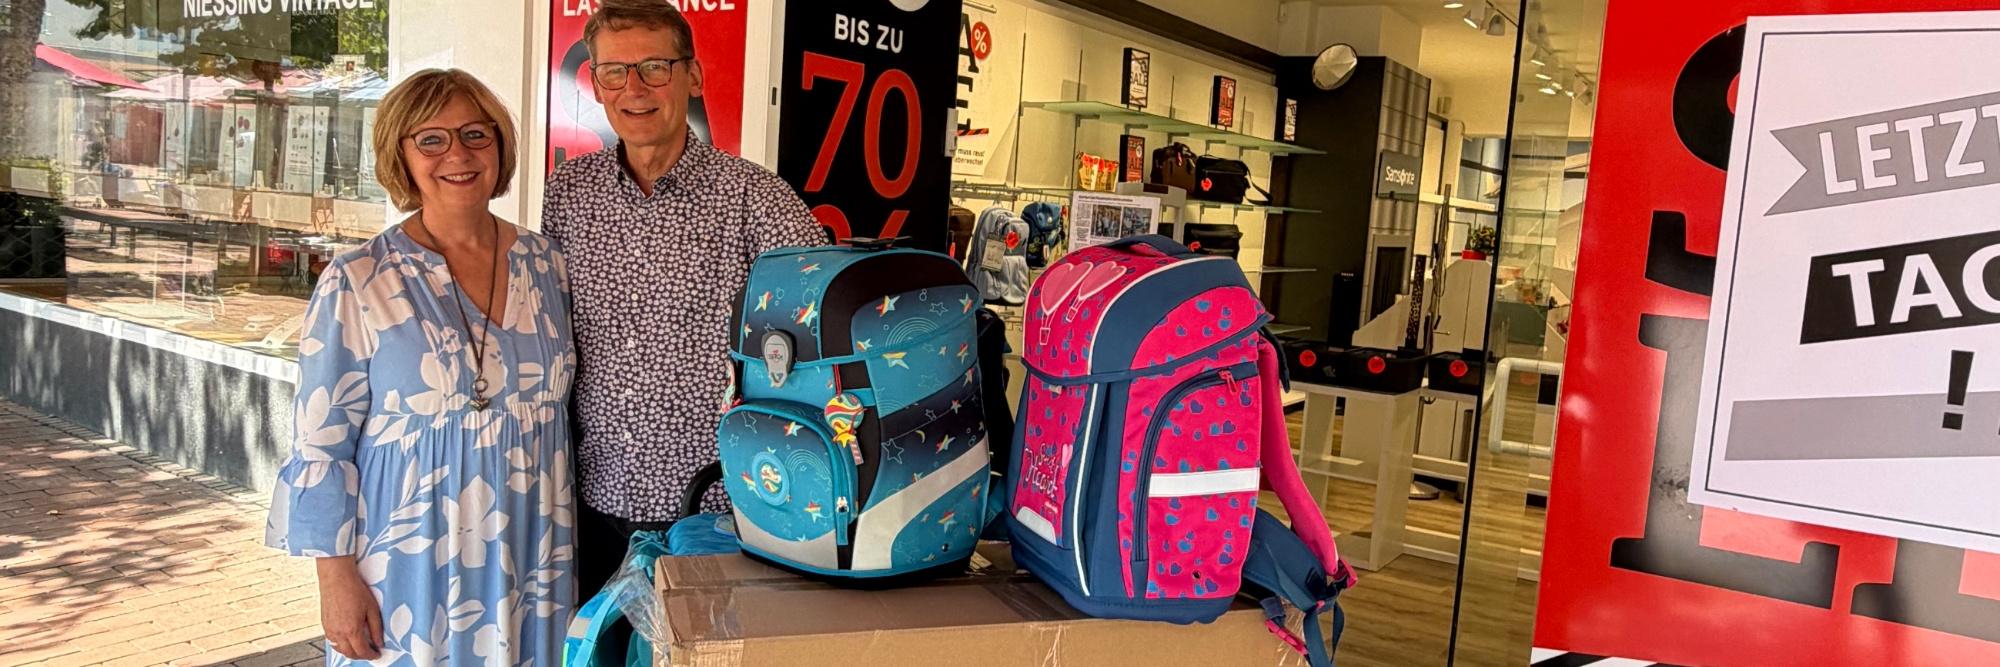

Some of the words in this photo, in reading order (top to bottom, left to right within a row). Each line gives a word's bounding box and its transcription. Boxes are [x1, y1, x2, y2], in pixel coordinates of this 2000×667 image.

[184, 0, 272, 18] NIESSING
[834, 13, 869, 46] BIS
[876, 25, 904, 53] ZU
[802, 51, 922, 199] 70
